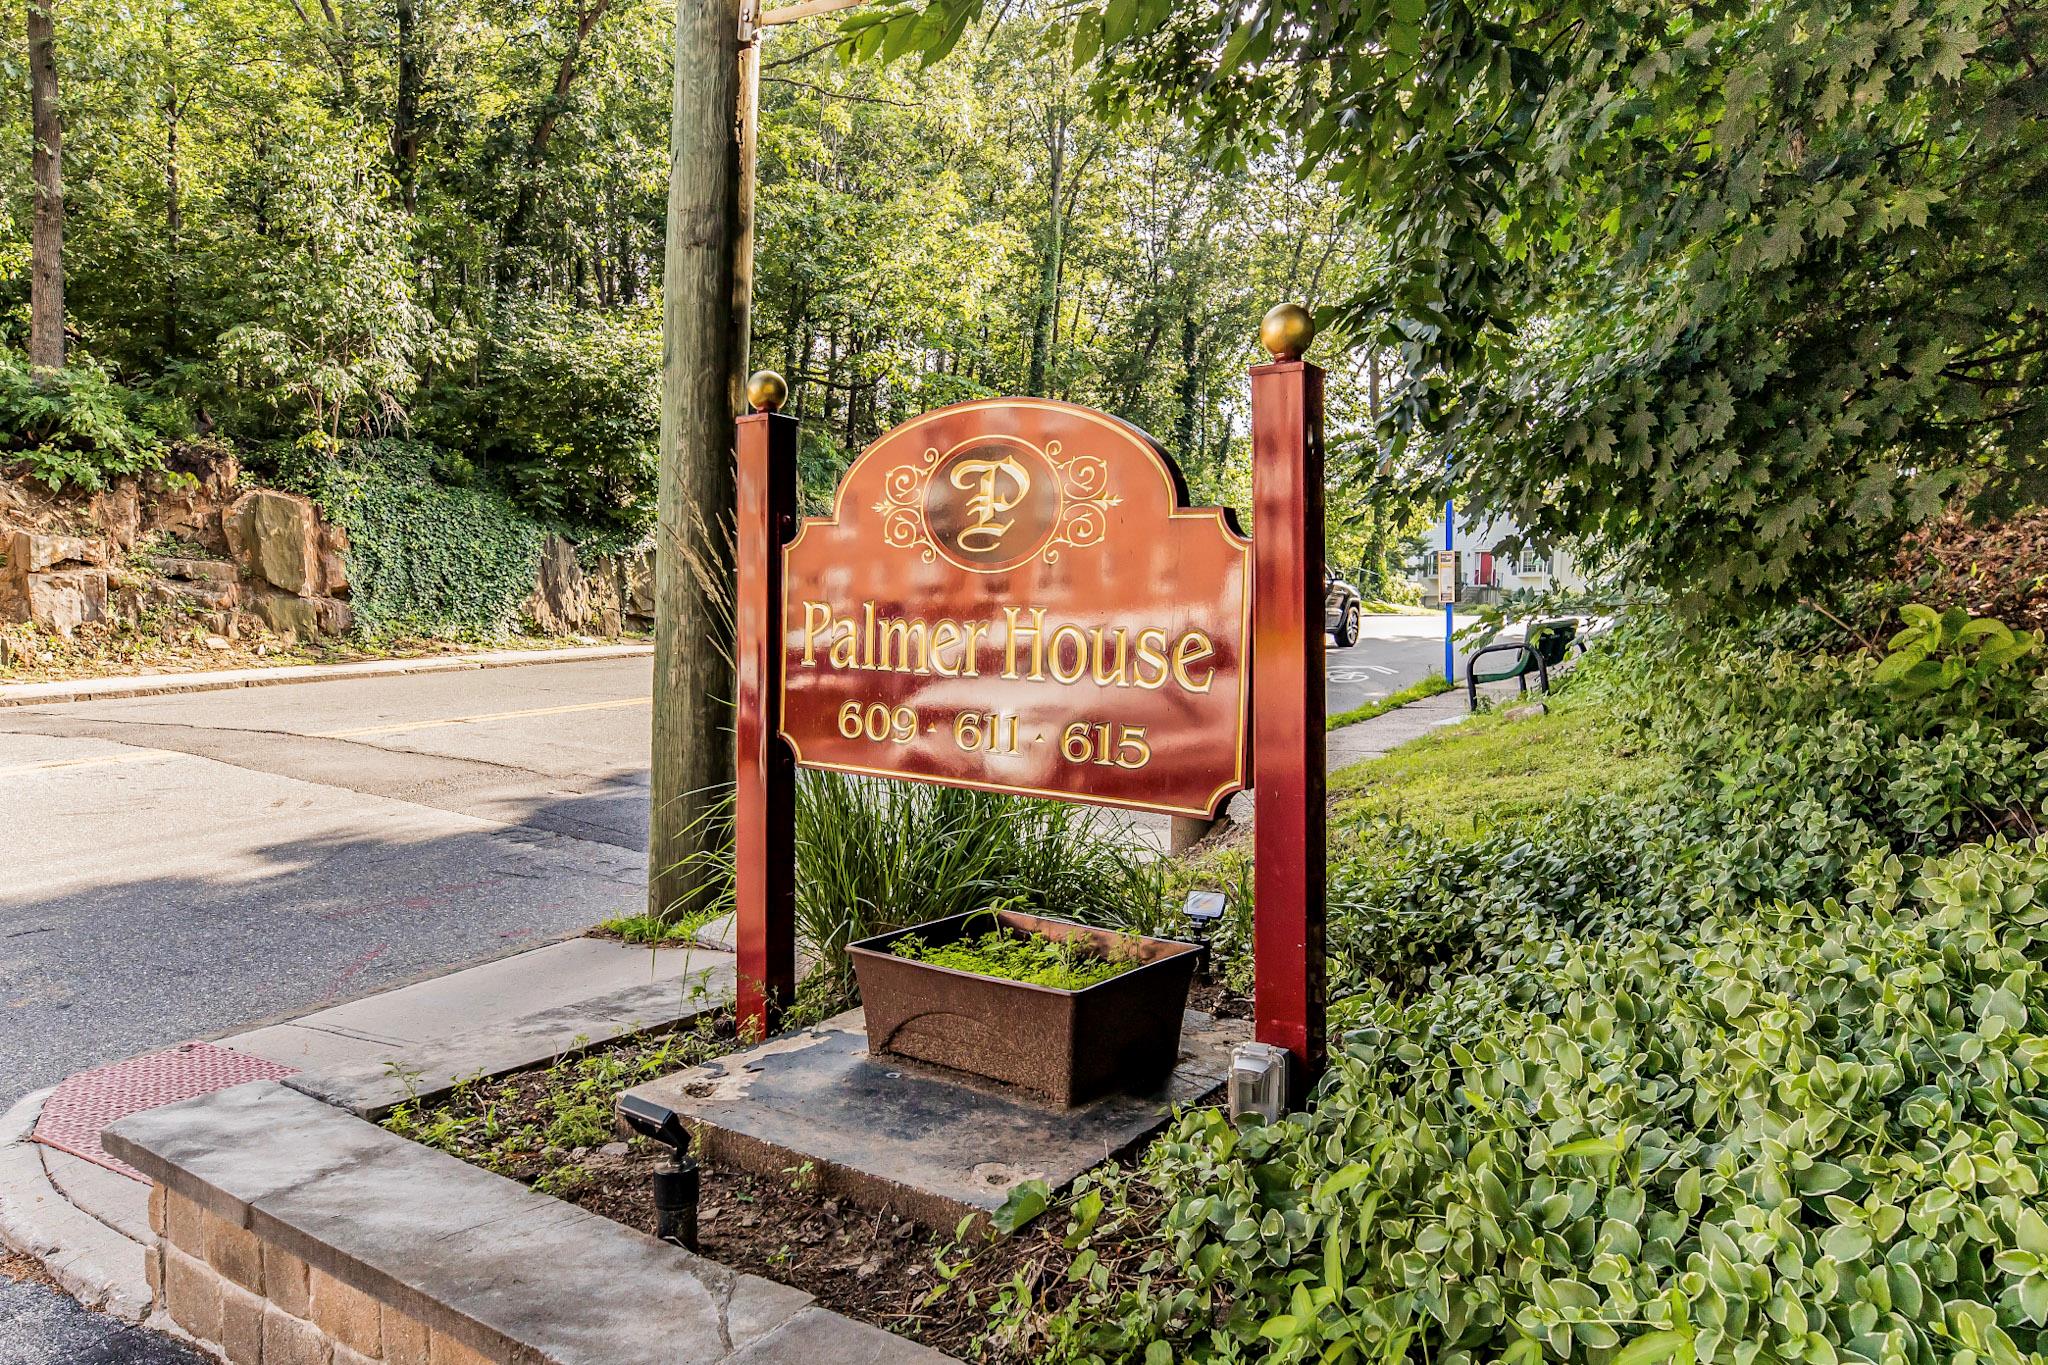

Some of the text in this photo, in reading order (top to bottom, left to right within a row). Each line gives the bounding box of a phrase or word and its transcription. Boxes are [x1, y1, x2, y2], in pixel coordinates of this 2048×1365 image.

[950, 455, 1031, 552] P
[801, 600, 1215, 694] Palmer House
[838, 700, 1151, 769] 609 611 615
